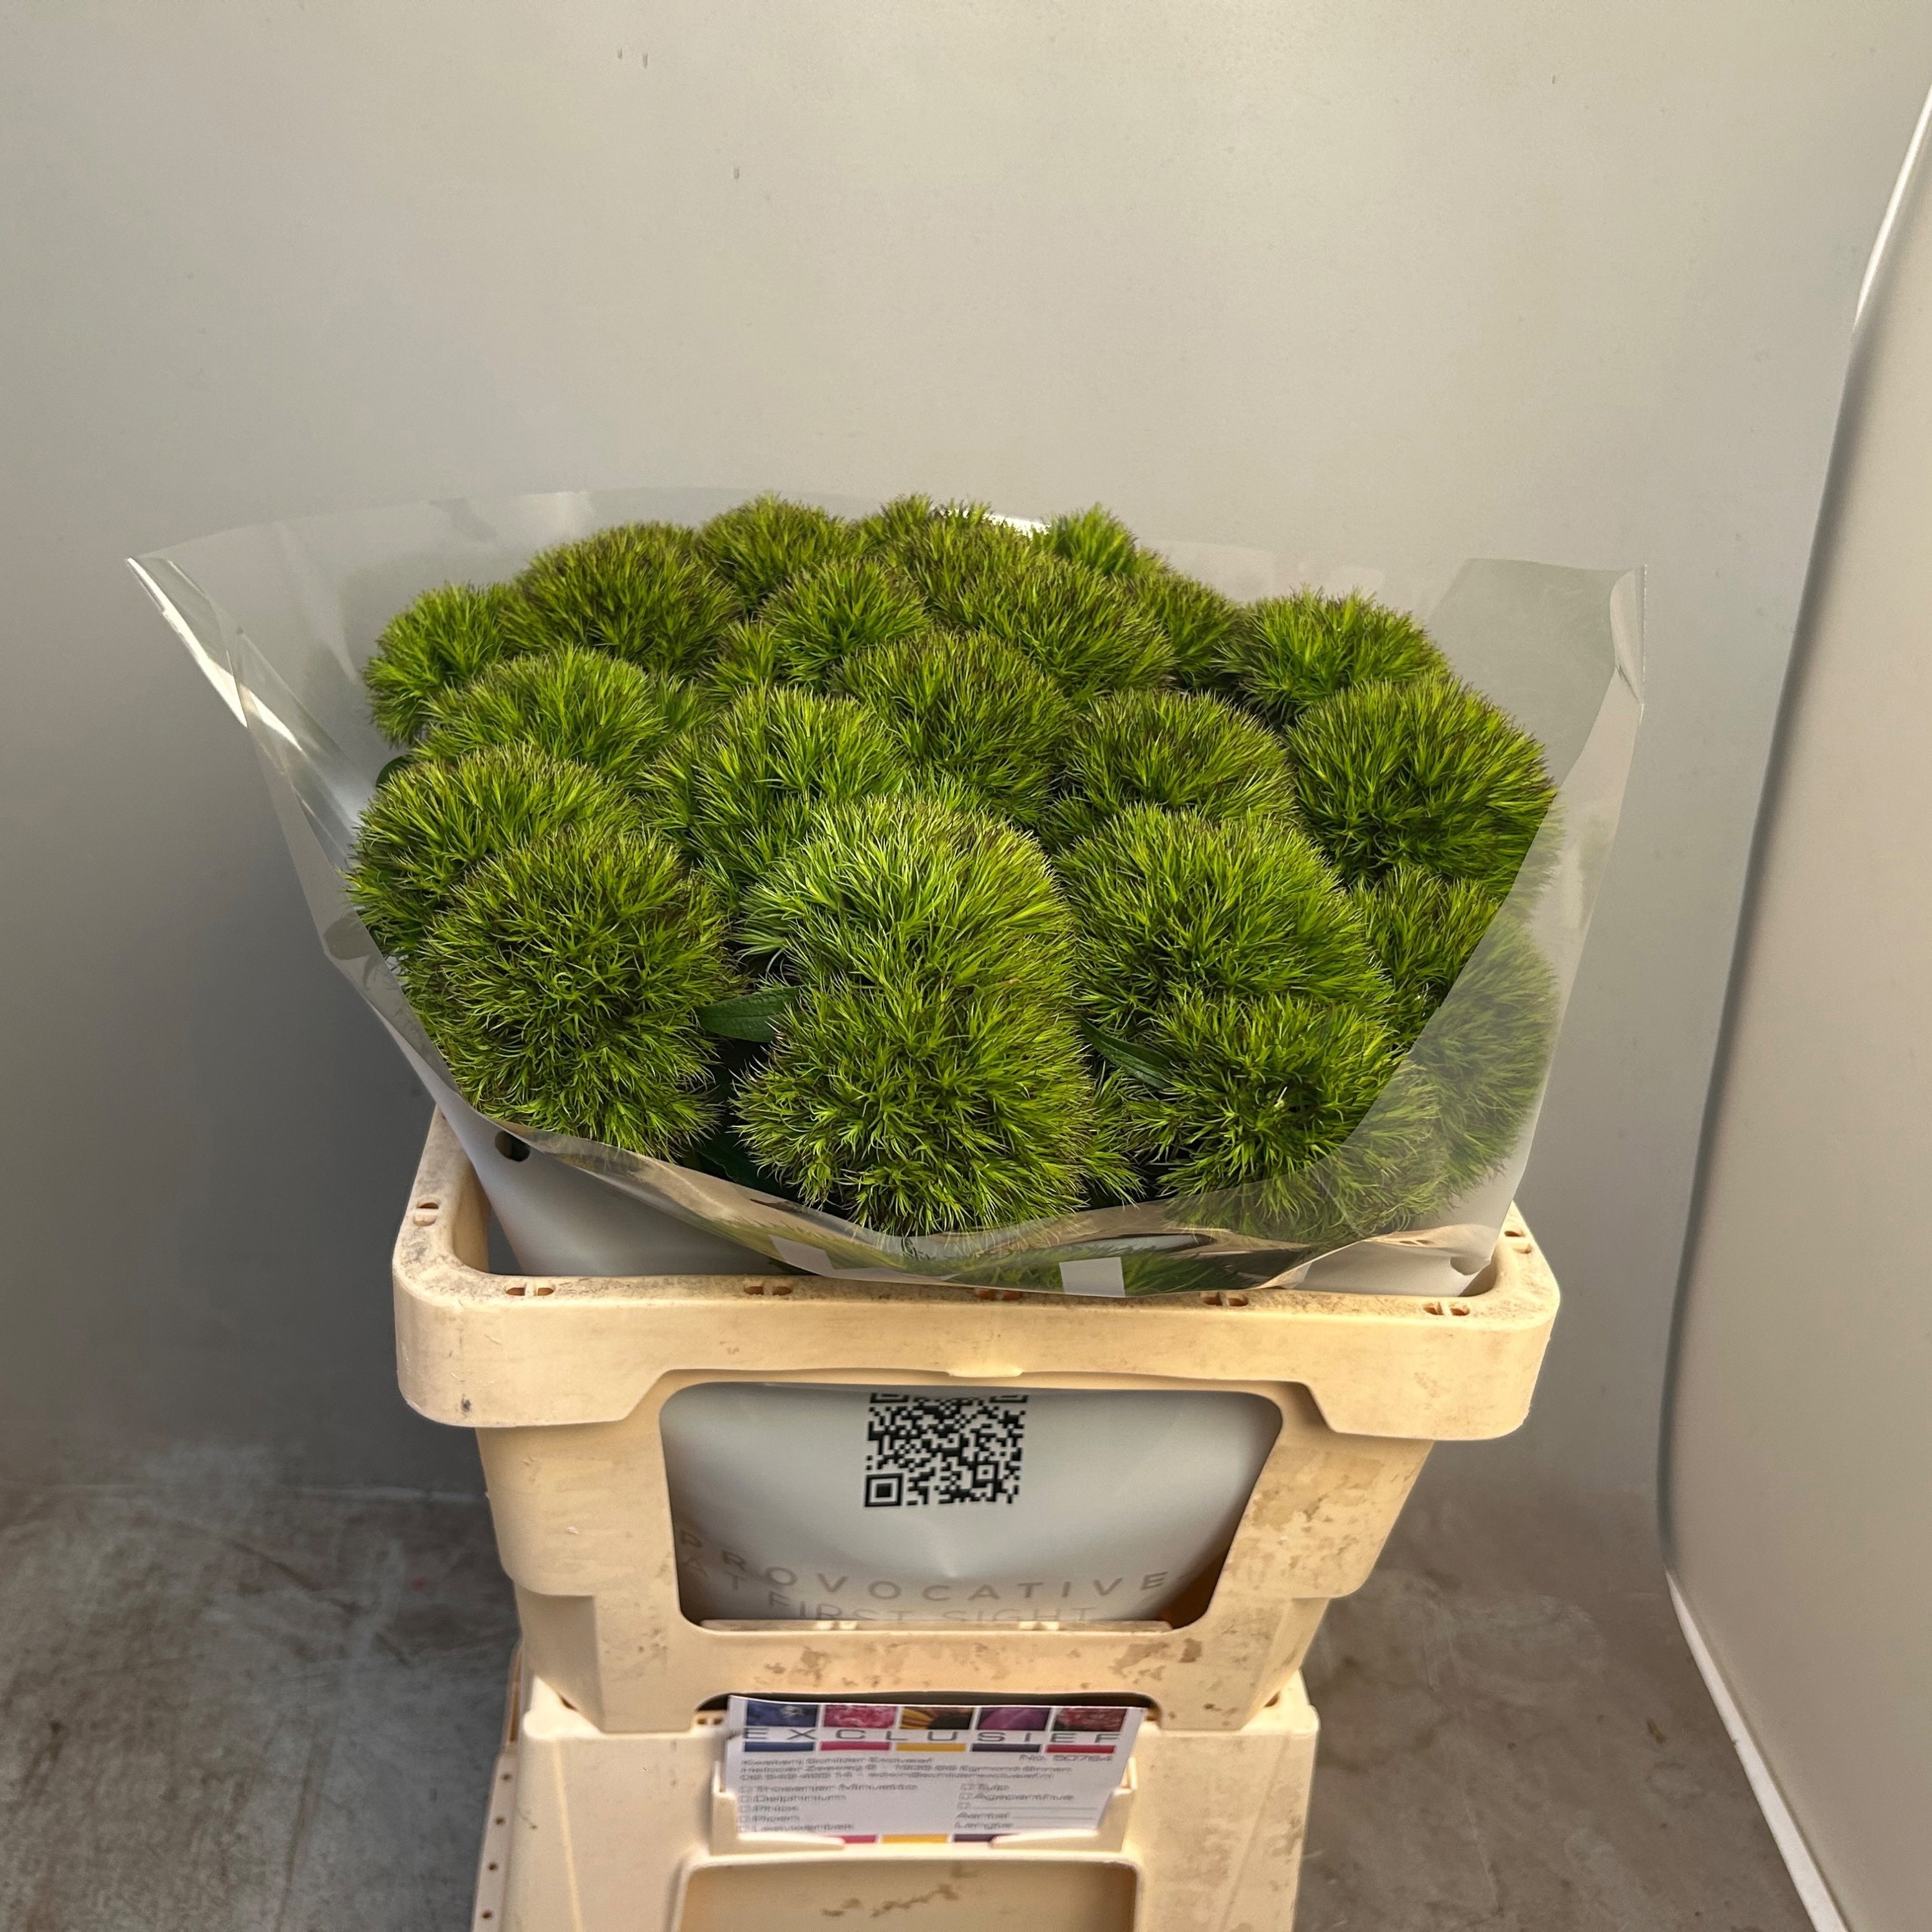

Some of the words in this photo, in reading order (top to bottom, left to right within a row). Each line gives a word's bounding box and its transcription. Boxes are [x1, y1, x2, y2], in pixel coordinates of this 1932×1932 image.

[680, 1529, 1168, 1602] PROVOCATIVE
[768, 1590, 913, 1621] FIRST
[743, 1727, 1120, 1743] EXCLUSIEF
